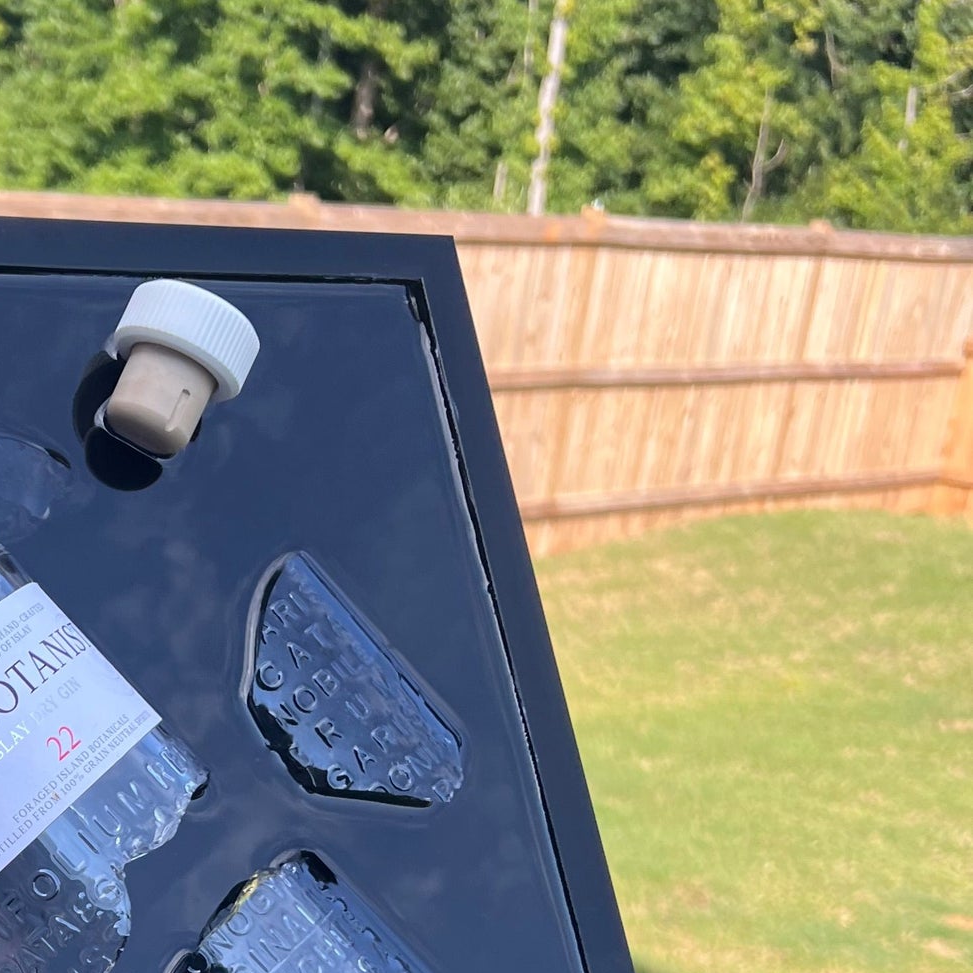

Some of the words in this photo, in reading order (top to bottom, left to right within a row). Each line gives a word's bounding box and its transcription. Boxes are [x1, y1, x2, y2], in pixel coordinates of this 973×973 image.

[2, 641, 13, 652] OF
[11, 624, 33, 643] ISLAY
[29, 696, 58, 726] DRY
[57, 676, 82, 700] GIN
[12, 780, 58, 824] FORAGED
[56, 752, 90, 783] ISLAND
[89, 713, 130, 753] BOTANICALS
[46, 726, 82, 761] 22
[32, 792, 61, 821] FROM
[60, 773, 85, 796] 100%
[83, 749, 109, 774] GRAIN
[108, 723, 139, 751] NEUTRAL
